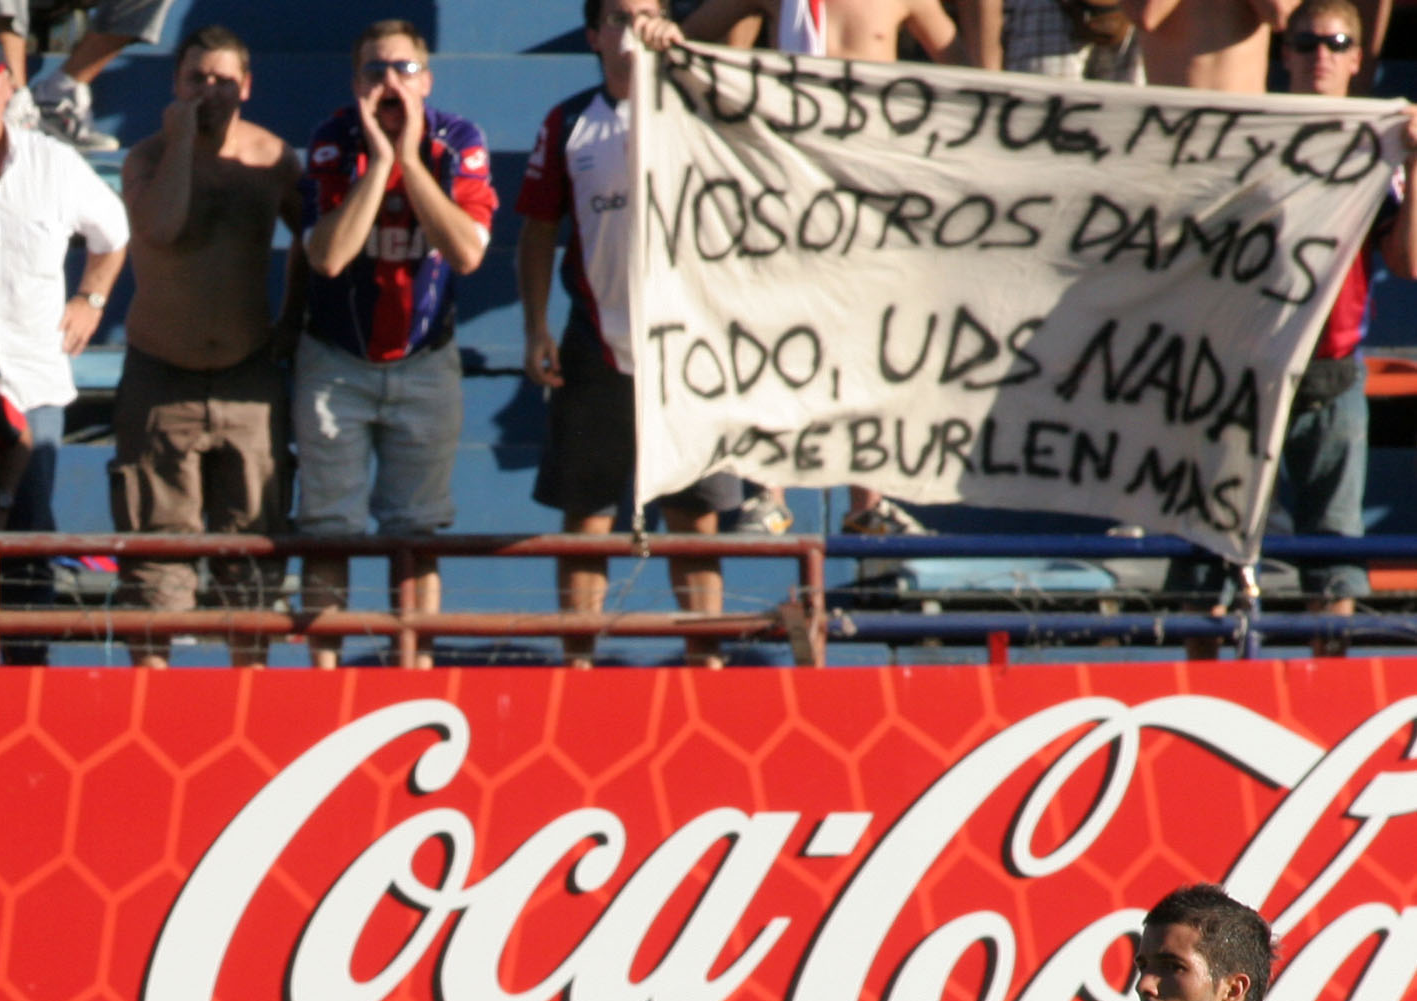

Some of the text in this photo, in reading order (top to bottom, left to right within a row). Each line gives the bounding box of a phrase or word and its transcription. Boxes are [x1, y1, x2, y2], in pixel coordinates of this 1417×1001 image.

[647, 164, 1339, 305] NOSOTROS DAMOS
[878, 305, 1046, 391] UDS
[847, 414, 1119, 486] BURLEN
